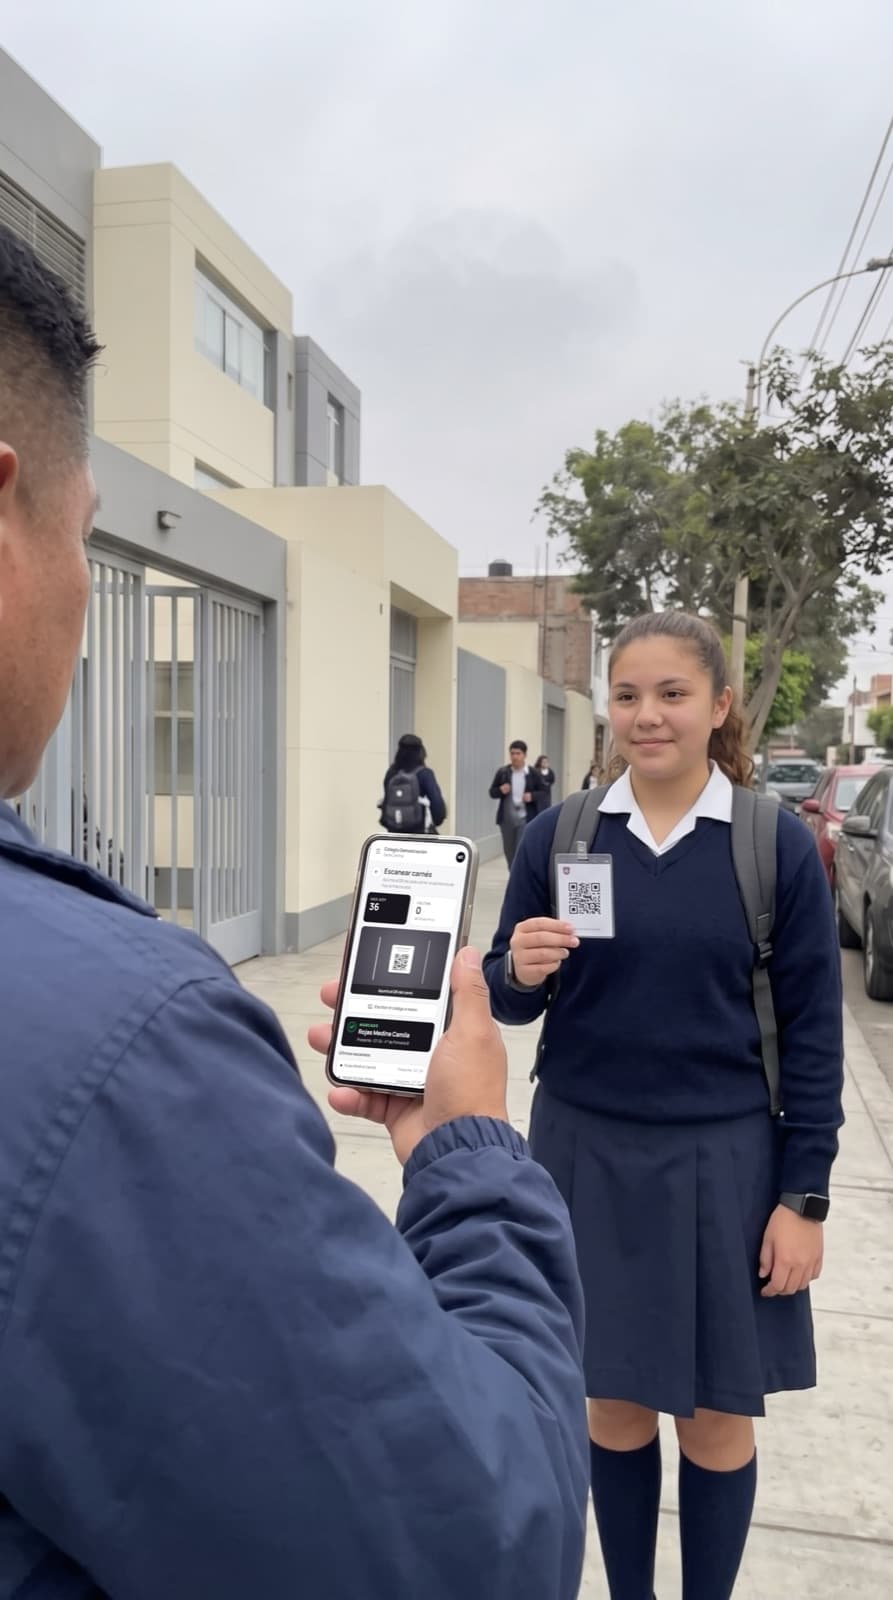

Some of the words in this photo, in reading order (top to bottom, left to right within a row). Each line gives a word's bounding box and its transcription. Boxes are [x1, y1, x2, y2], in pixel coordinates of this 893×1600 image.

[384, 867, 410, 876] Escanear
[369, 902, 380, 911] 36
[415, 906, 422, 915] 0
[358, 1028, 372, 1037] Rojas
[392, 1031, 410, 1039] Camila
